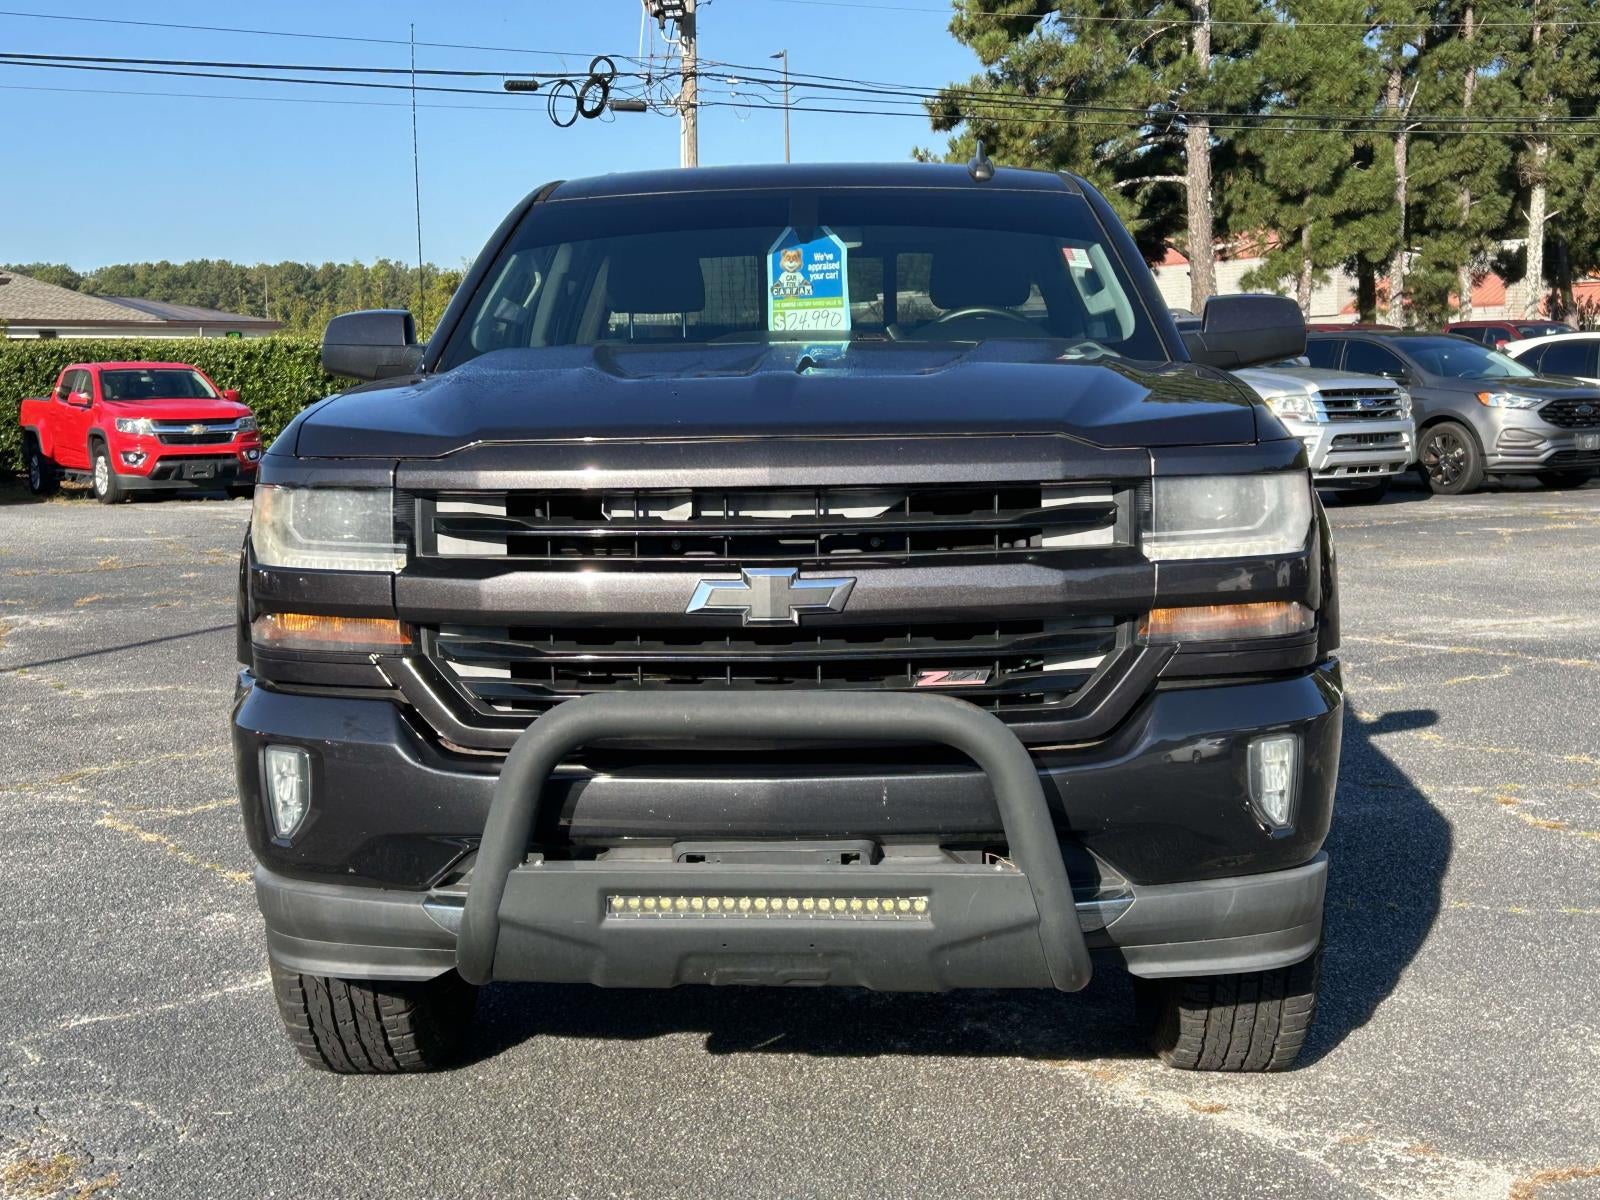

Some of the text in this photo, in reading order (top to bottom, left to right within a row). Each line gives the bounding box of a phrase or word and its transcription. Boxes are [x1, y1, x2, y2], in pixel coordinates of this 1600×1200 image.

[814, 252, 834, 261] We've
[808, 261, 840, 271] appraised
[810, 272, 839, 282] your car!
[772, 286, 812, 295] CARFAX
